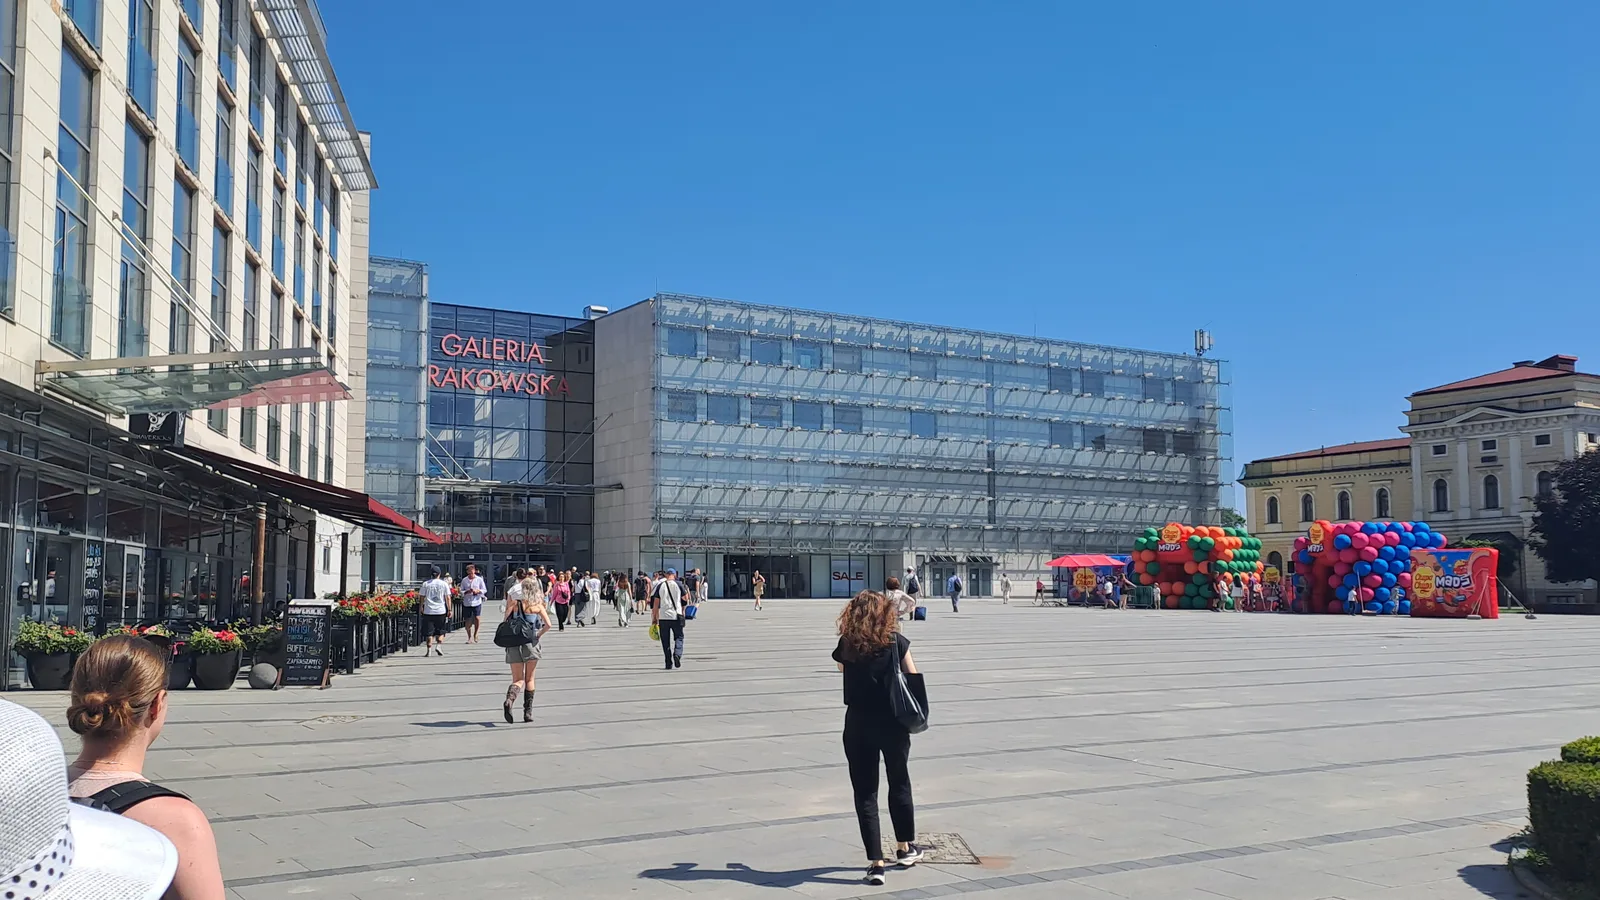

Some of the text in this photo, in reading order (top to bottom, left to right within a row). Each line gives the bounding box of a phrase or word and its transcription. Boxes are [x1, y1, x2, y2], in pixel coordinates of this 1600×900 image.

[441, 333, 544, 364] GALERIA
[427, 364, 571, 396] RAKOWSKA
[482, 532, 562, 545] KRAKOWSKA
[833, 572, 864, 581] SALE
[286, 644, 308, 653] BUFET
